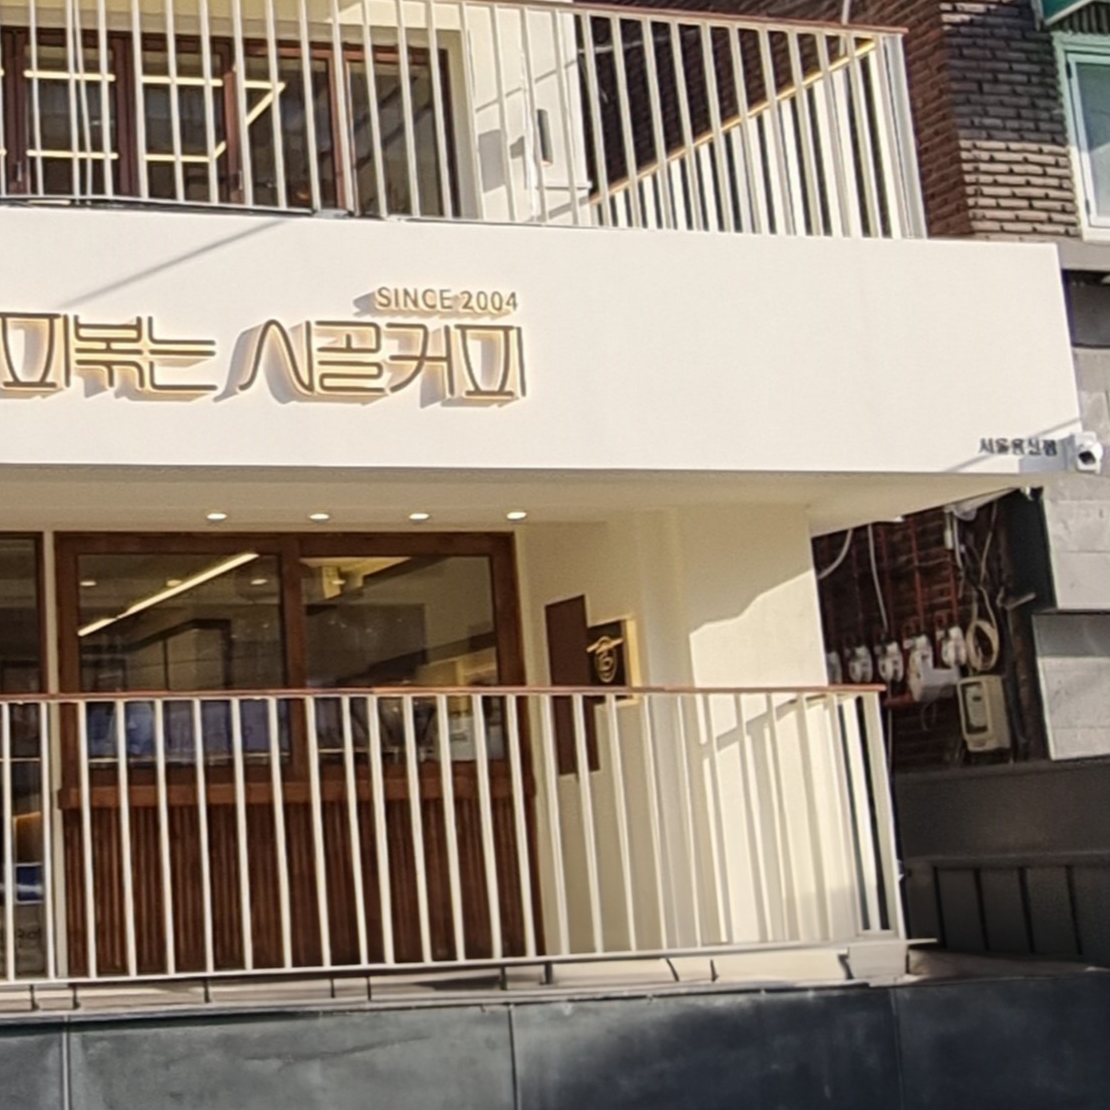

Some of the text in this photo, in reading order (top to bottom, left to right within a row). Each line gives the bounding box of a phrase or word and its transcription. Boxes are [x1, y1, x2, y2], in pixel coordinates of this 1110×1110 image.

[376, 286, 519, 312] SINCE 2004
[238, 319, 527, 398] 시골커피
